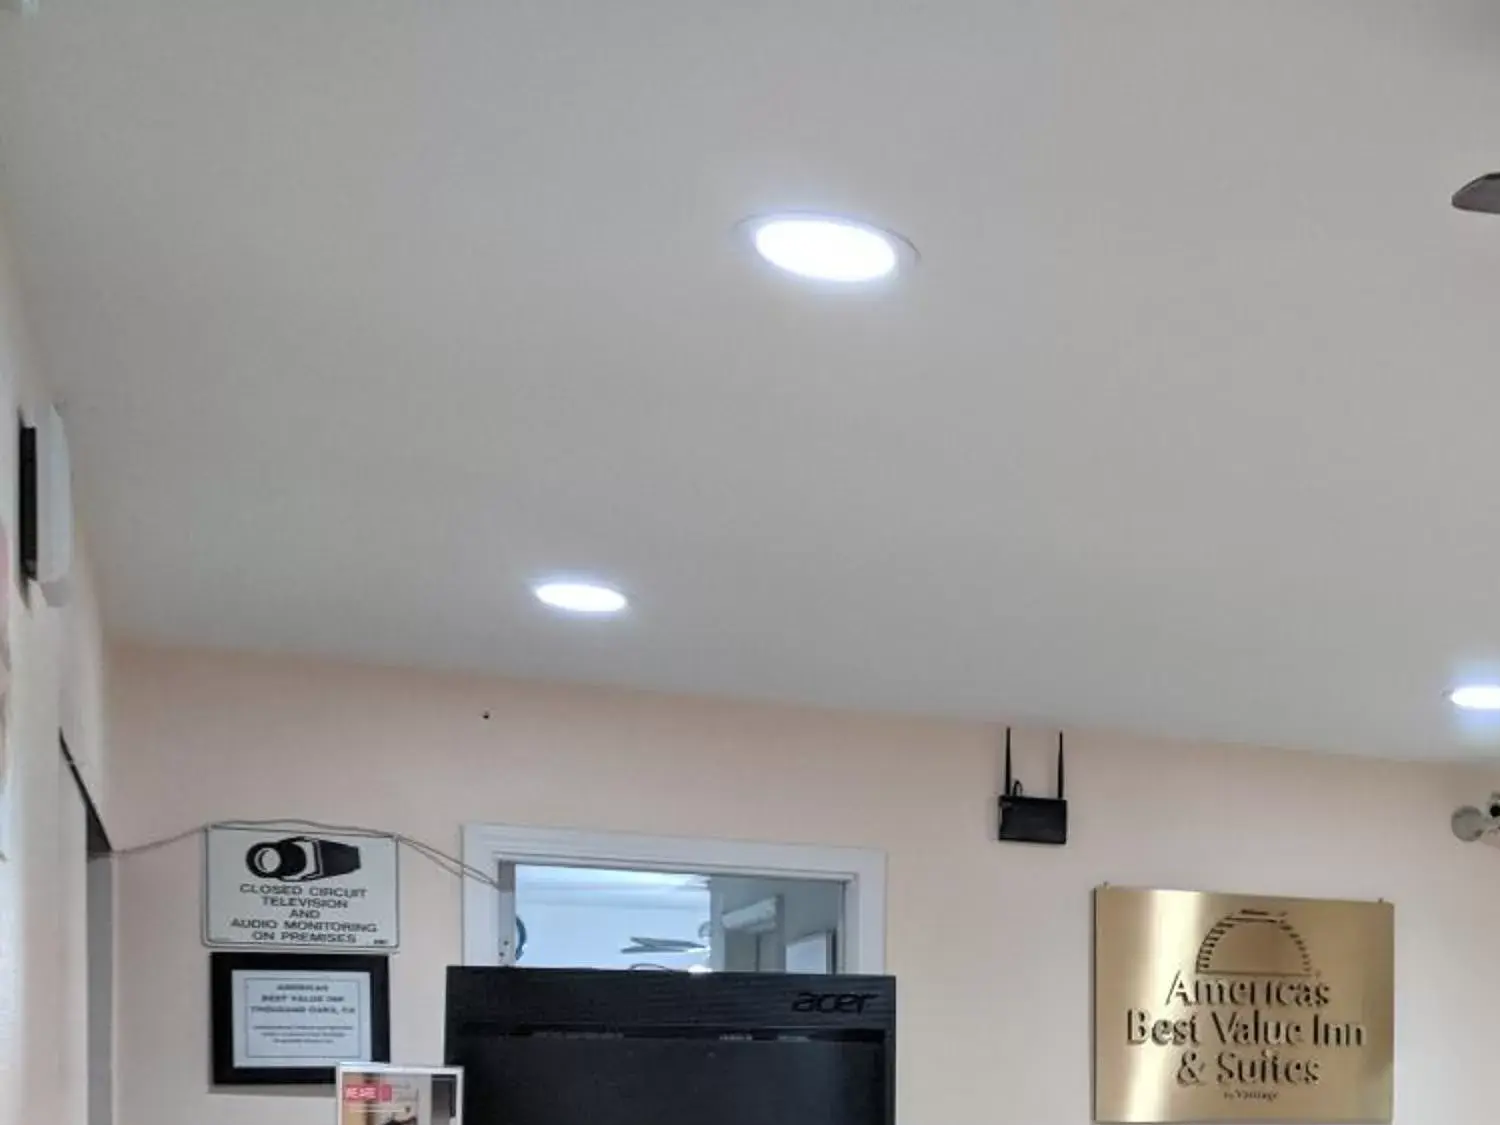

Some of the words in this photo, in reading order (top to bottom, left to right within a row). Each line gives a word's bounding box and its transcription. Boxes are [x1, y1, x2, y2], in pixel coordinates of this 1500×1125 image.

[239, 883, 303, 896] CLOSED
[308, 885, 368, 899] CIRCUIT
[262, 896, 349, 909] TELEVISION
[288, 908, 320, 919] AND
[230, 918, 278, 930] AUDIO
[283, 919, 378, 933] MONITORING
[251, 930, 275, 942] ON
[280, 931, 357, 944] PREMISES
[1164, 969, 1332, 1008] Americas
[791, 991, 880, 1015] acer
[1126, 1008, 1200, 1046] Best
[1211, 1009, 1304, 1046] Value
[1312, 1013, 1366, 1047] Inn
[1176, 1049, 1208, 1086] &
[1216, 1049, 1321, 1086] Suites
